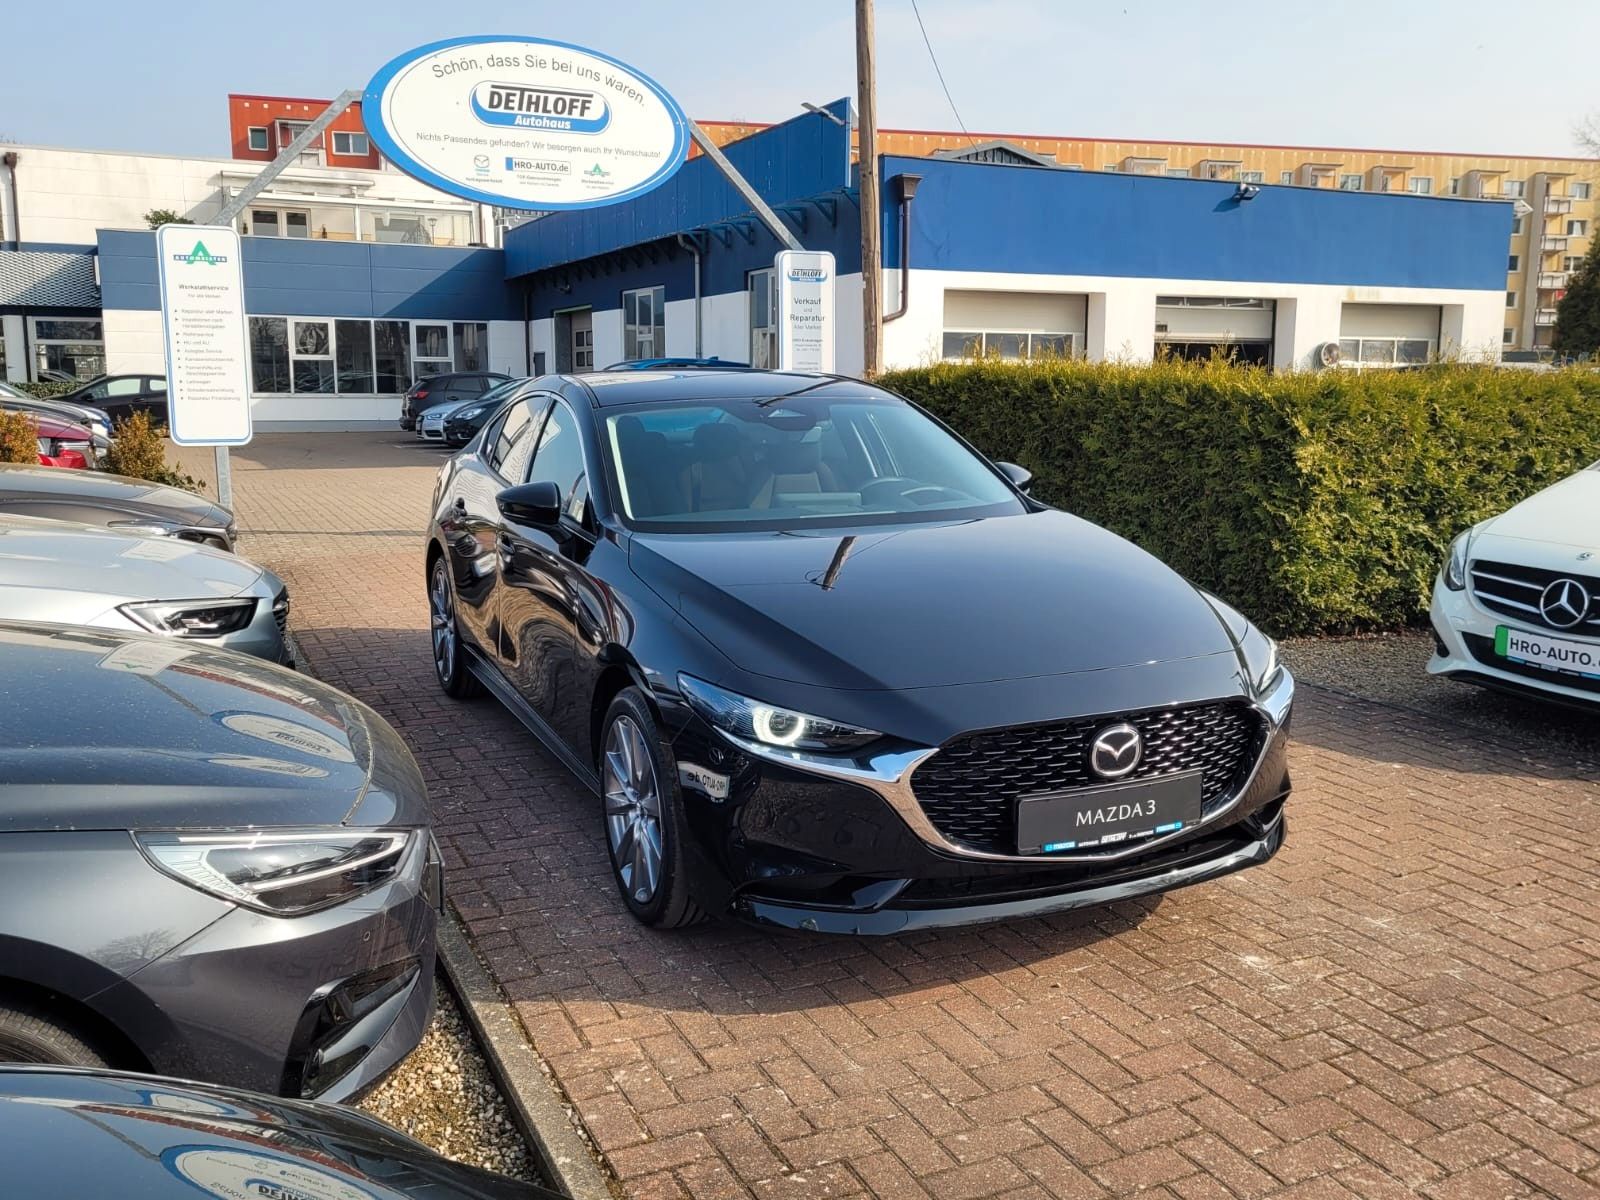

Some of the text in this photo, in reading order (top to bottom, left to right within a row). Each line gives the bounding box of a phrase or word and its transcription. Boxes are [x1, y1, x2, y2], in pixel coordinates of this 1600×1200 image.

[432, 54, 645, 107] Schön, dass Sie bei uns waren.
[488, 84, 594, 117] DETHLOFF
[514, 115, 571, 129] Autohaus
[416, 132, 441, 141] Nichts
[443, 134, 487, 145] Passendes
[489, 138, 529, 148] gefunden?
[532, 141, 545, 149] Wir
[547, 142, 582, 153] besorgen
[583, 146, 601, 154] auch
[614, 148, 661, 158] Wunschauto!
[514, 160, 569, 172] HRO-AUTO.de
[794, 297, 821, 305] Verkauf
[790, 314, 825, 322] Reparatur
[1510, 637, 1600, 668] HRO-AUTO.
[1075, 799, 1156, 827] MAZDA 3
